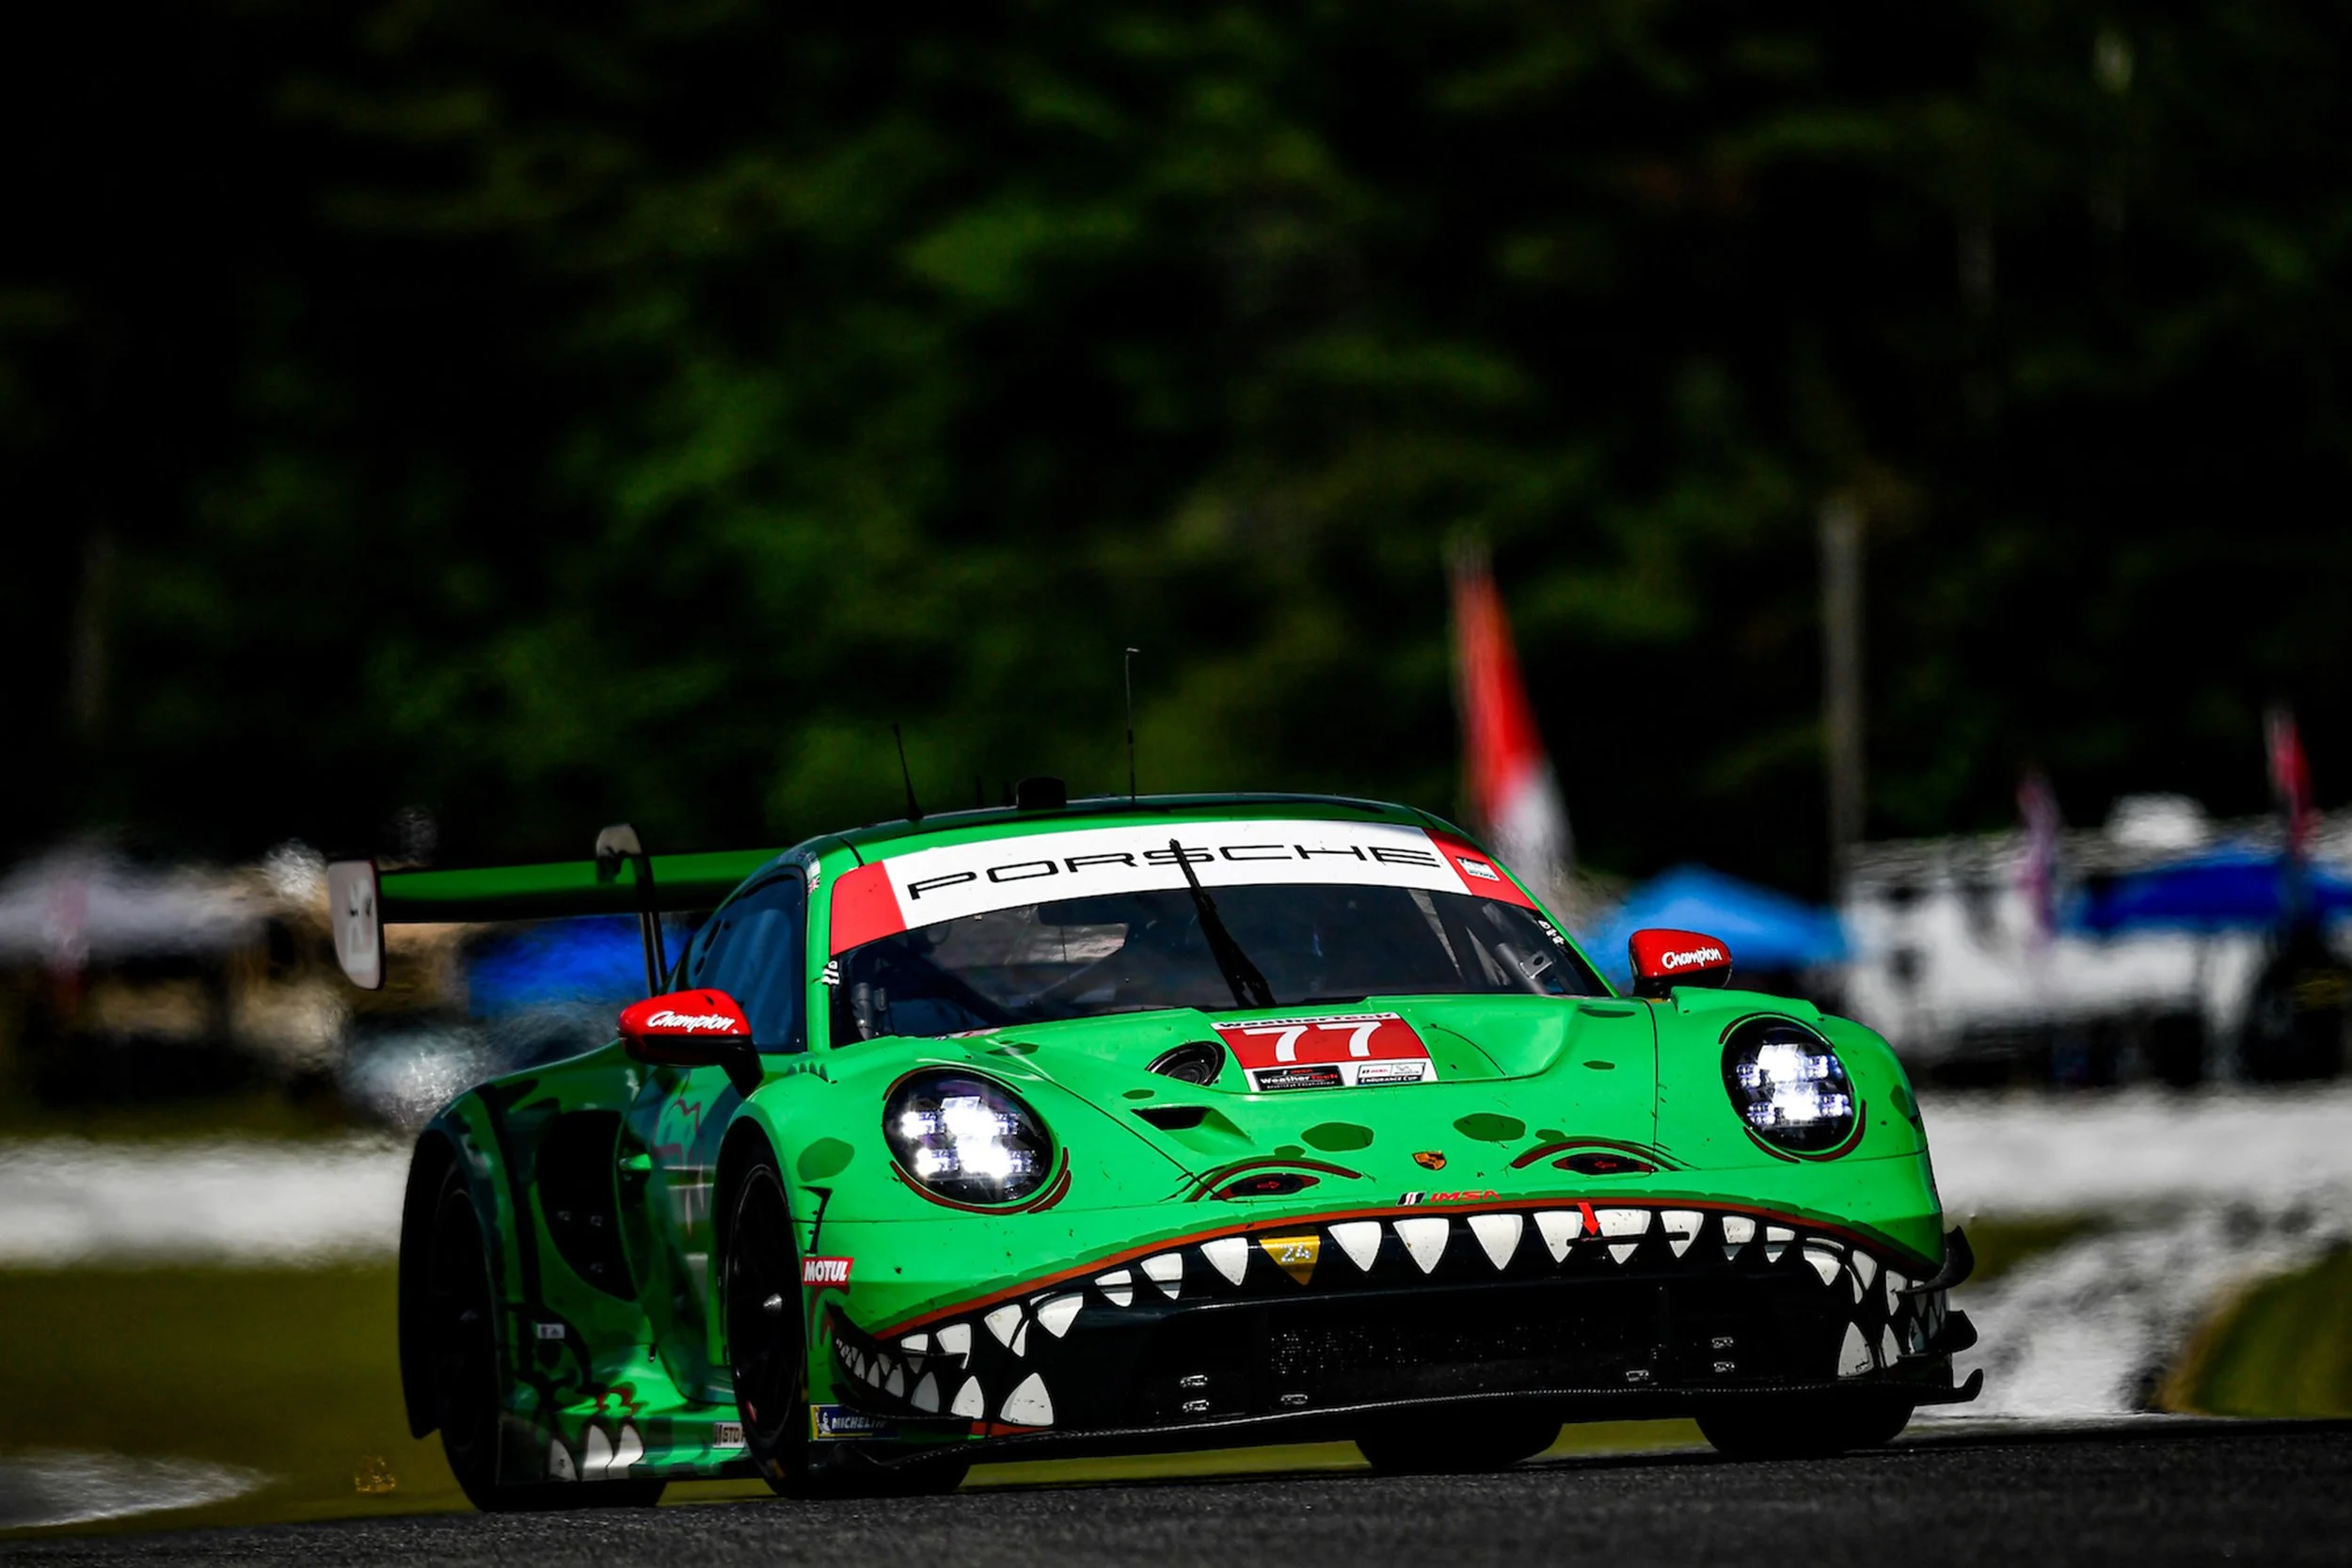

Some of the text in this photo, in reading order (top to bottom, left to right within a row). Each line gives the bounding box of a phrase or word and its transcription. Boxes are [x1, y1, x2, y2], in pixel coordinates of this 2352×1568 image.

[907, 844, 1441, 900] PORSCHE
[1661, 947, 1723, 969] Champion
[647, 1010, 736, 1033] Champion
[1243, 1021, 1382, 1062] 77
[1280, 1243, 1311, 1262] 24
[804, 1260, 848, 1282] MOTUL
[831, 1416, 887, 1430] MICHELIN
